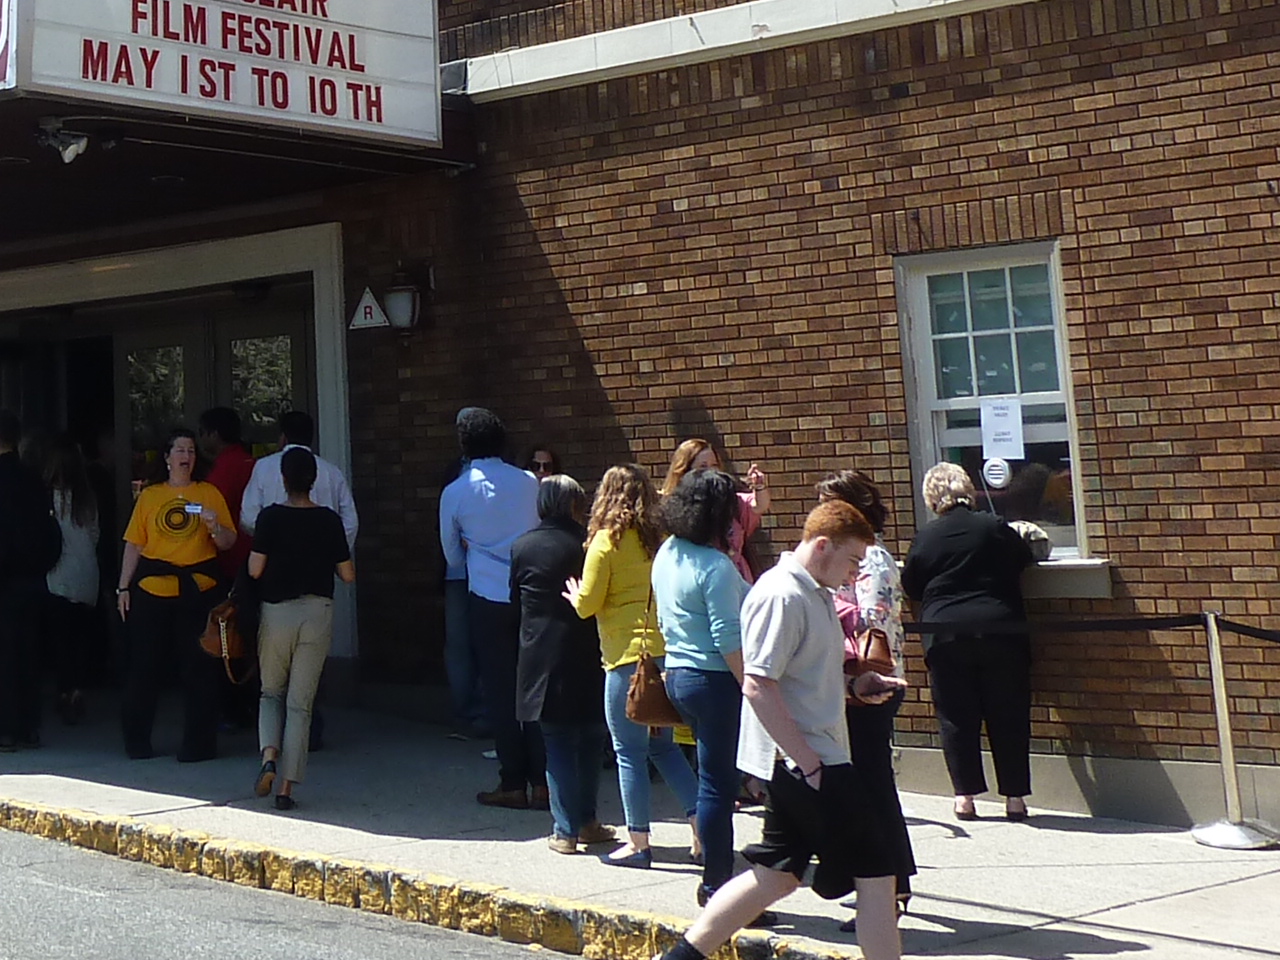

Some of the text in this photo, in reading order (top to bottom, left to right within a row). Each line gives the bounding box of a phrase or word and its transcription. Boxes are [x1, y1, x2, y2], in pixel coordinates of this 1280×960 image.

[221, 11, 366, 72] FESTIVAL
[81, 38, 160, 89] MAY
[251, 67, 289, 110] TO
[309, 75, 383, 124] 10TH
[364, 305, 374, 320] R
